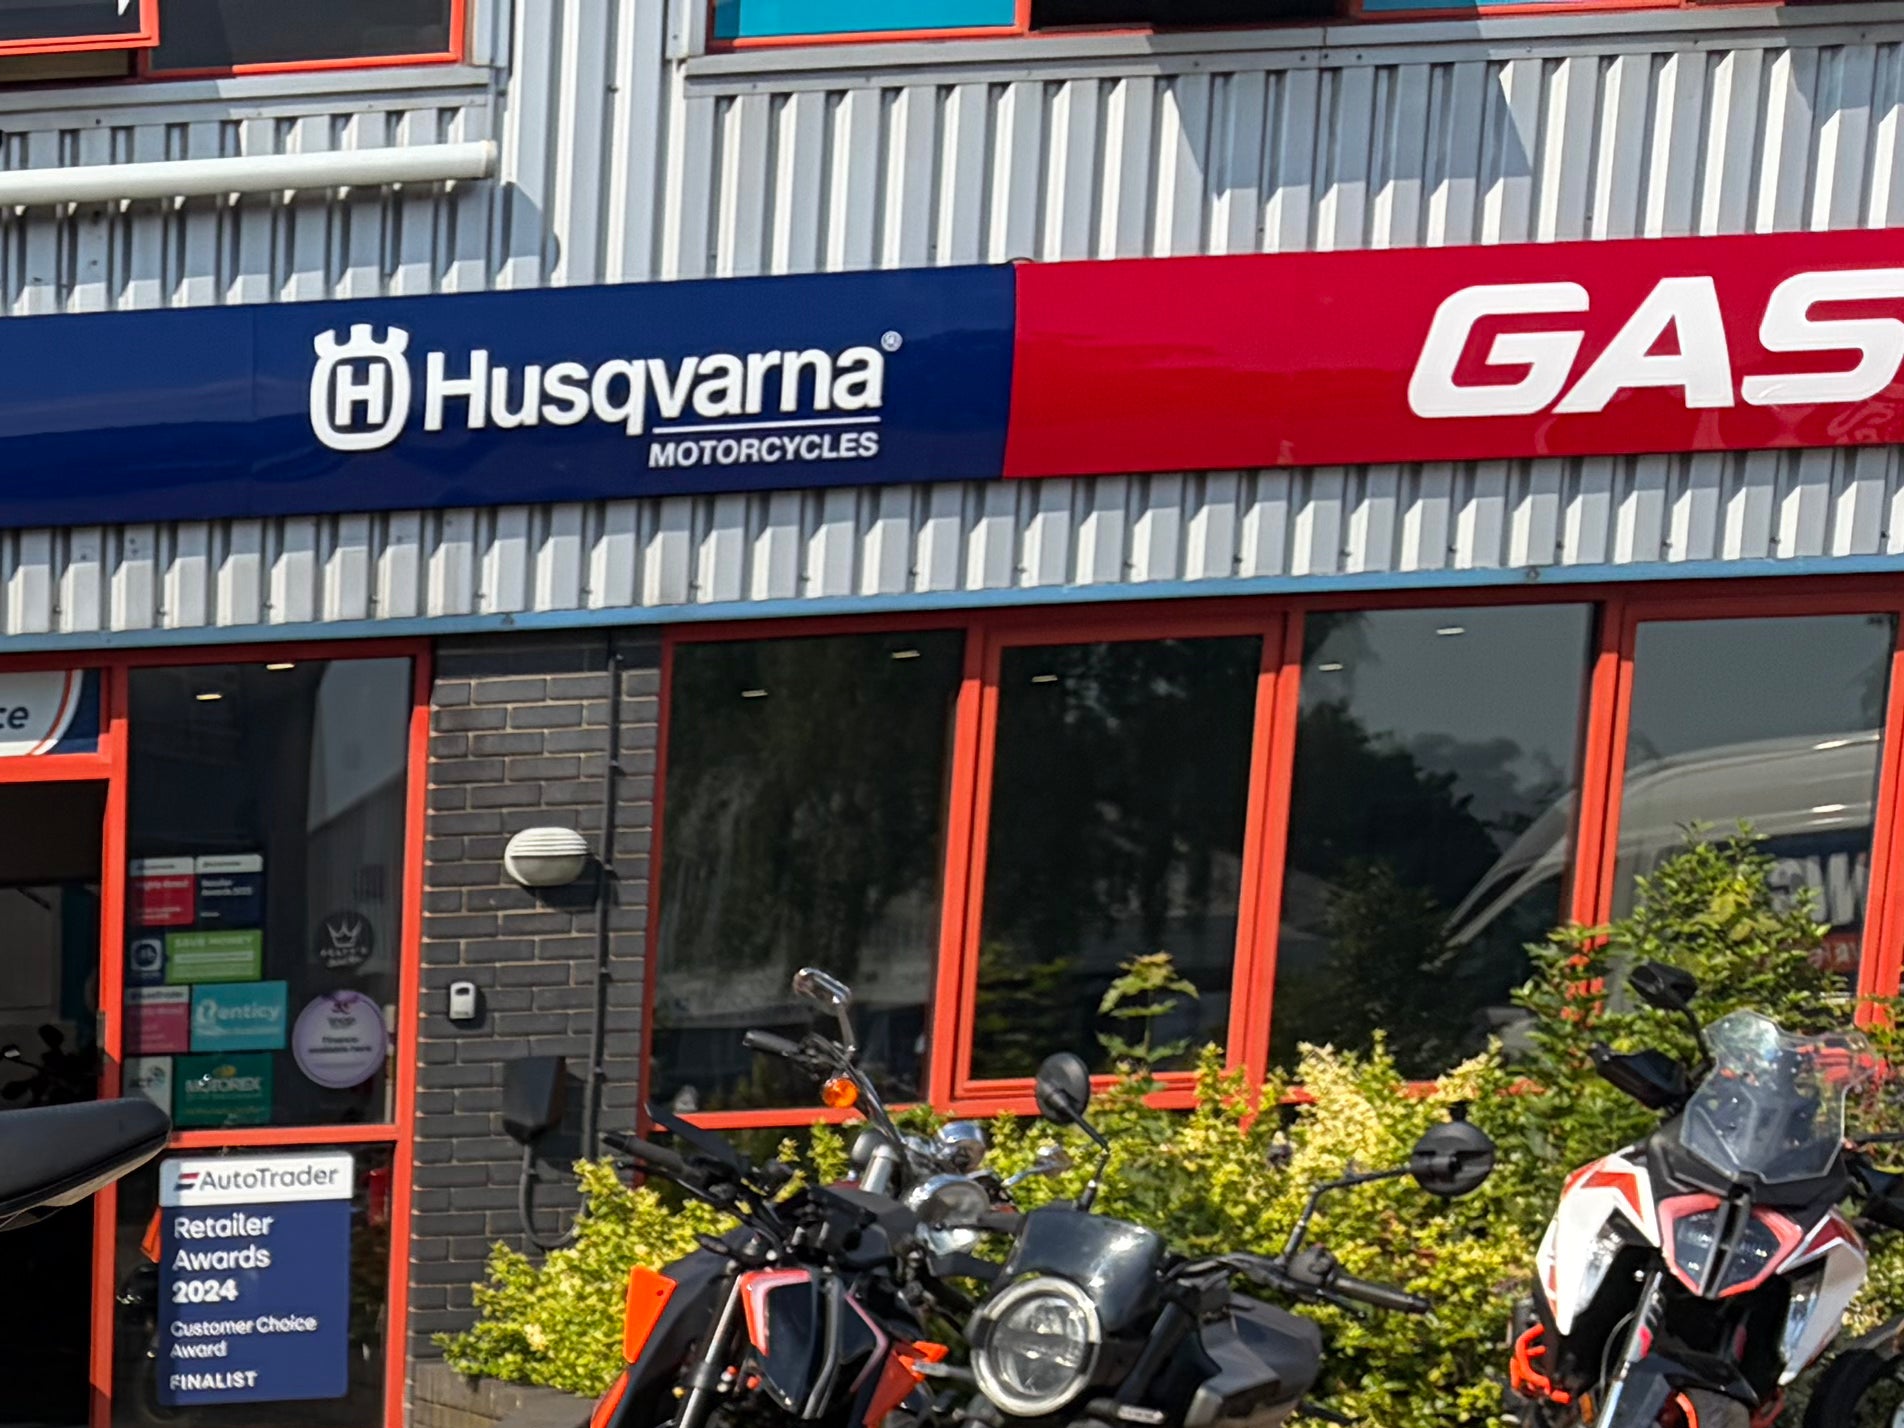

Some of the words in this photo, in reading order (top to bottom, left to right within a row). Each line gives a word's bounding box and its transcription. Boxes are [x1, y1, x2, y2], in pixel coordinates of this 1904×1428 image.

[424, 345, 884, 437] Husqvarna
[647, 430, 882, 470] MOTORCYCLES
[199, 1165, 339, 1192] AutoTrader
[174, 1212, 274, 1239] Retailer
[172, 1244, 272, 1271] Awards
[171, 1278, 239, 1304] 2024
[170, 1319, 254, 1338] Customer
[256, 1314, 318, 1334] Choice
[170, 1339, 228, 1360] Award
[170, 1370, 258, 1391] FINALIST
